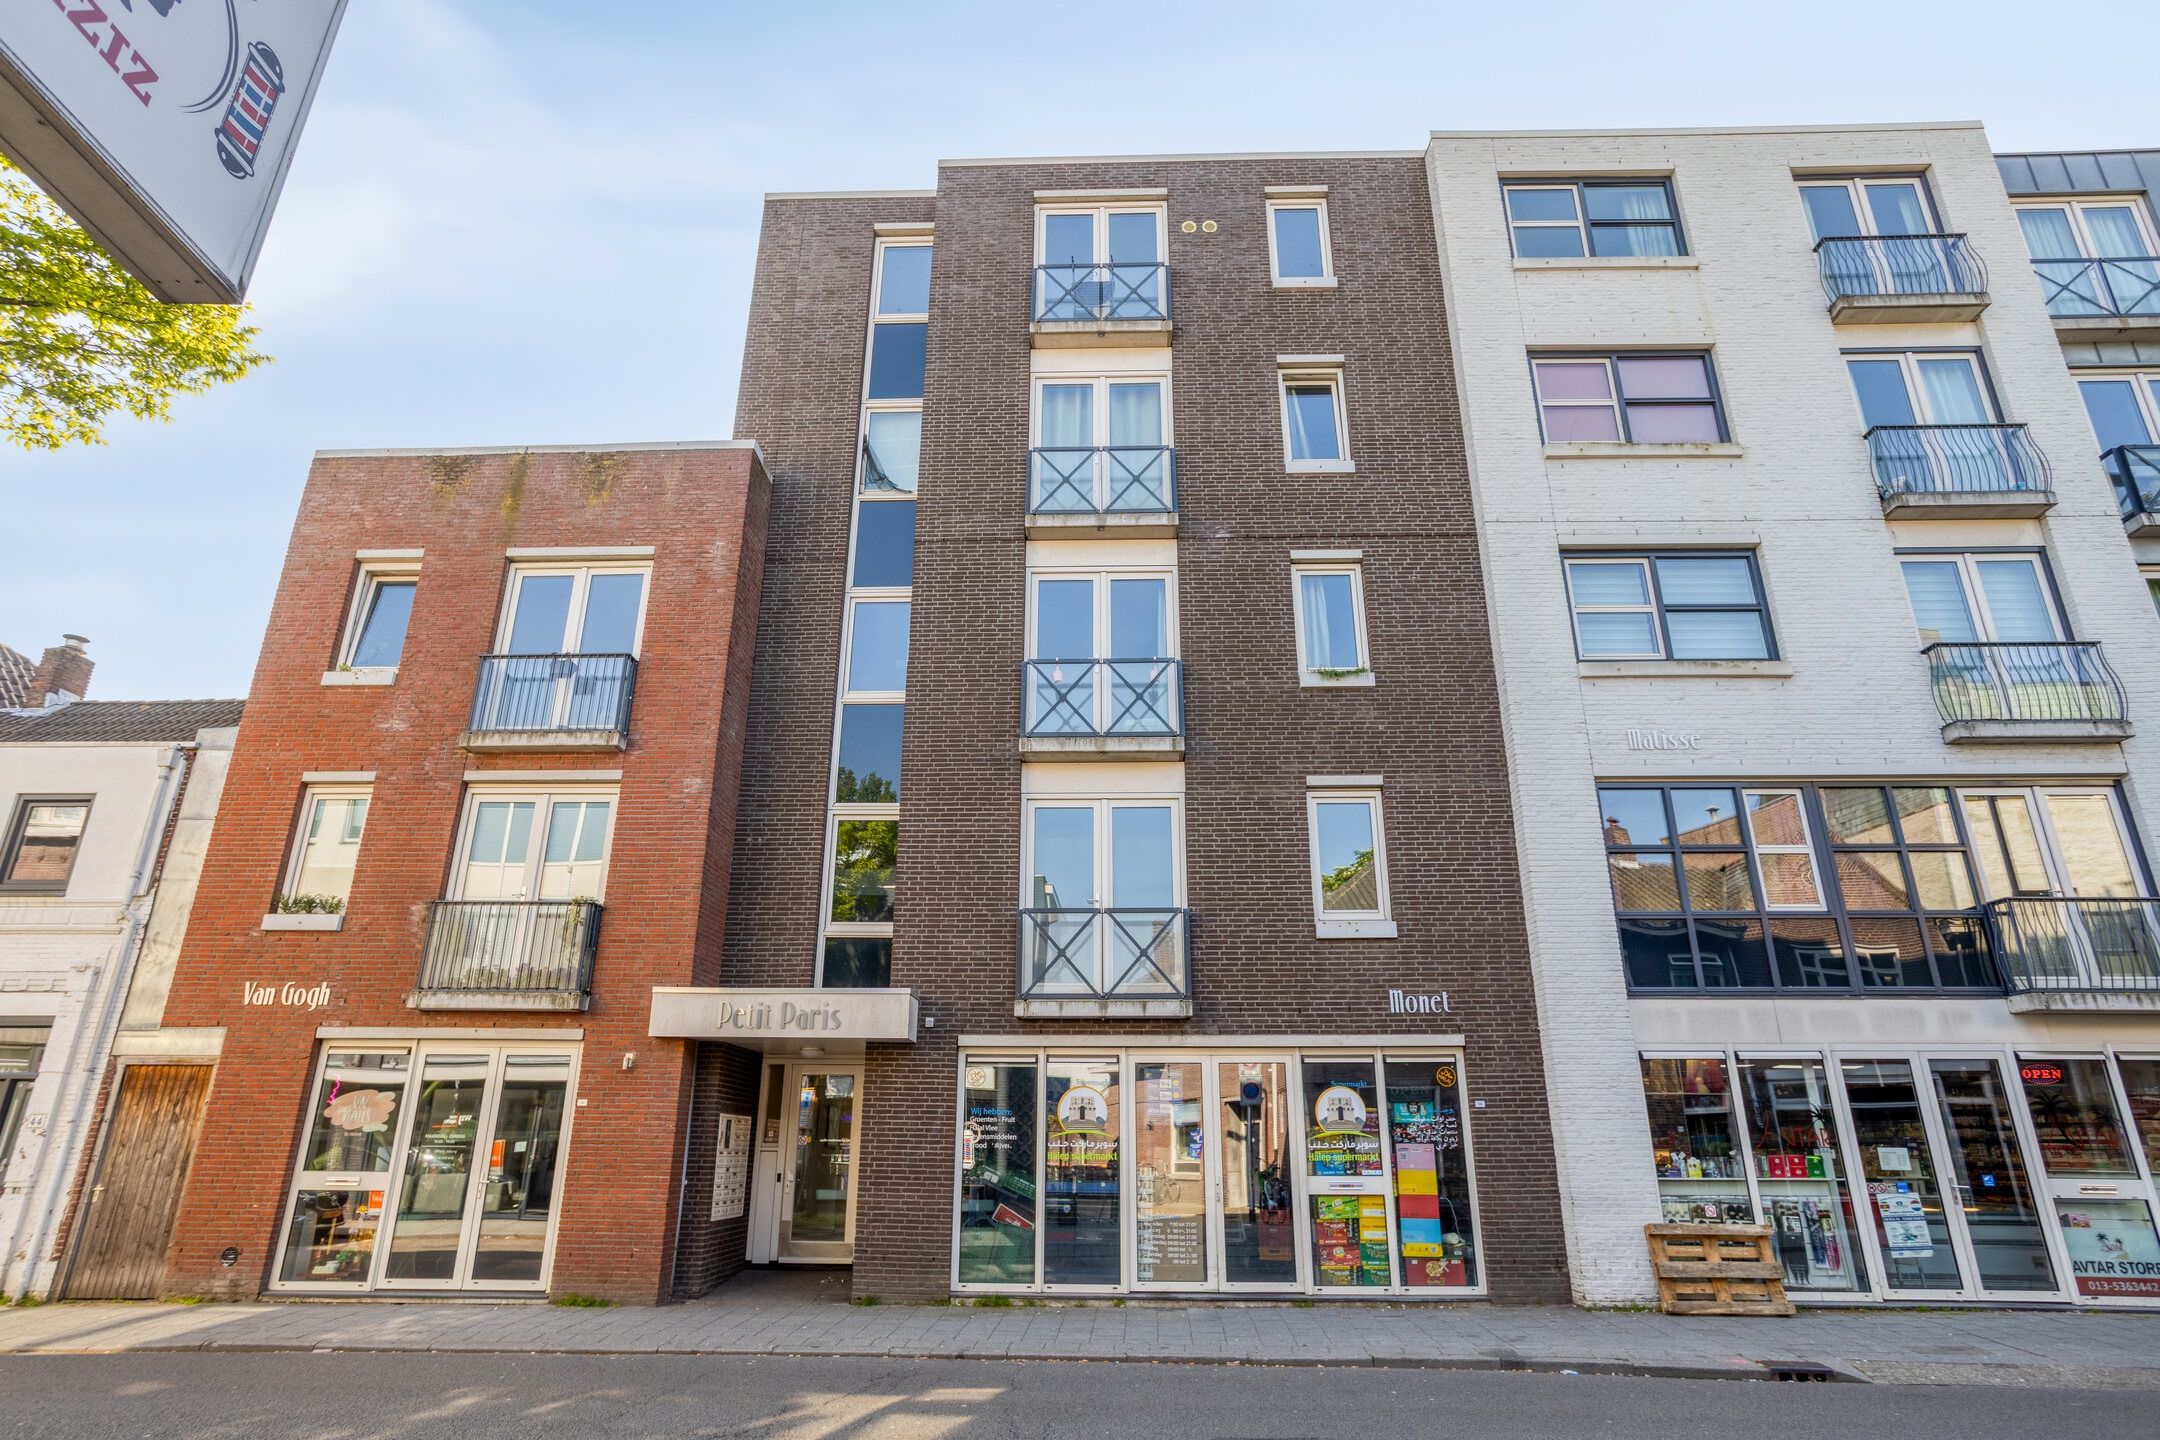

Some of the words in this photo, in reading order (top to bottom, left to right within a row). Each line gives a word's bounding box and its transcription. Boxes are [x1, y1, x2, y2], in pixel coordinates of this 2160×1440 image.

[53, 0, 159, 107] ZIZ
[1626, 729, 1701, 751] Matisse
[244, 981, 276, 1006] Van
[282, 981, 331, 1012] Gogh
[1389, 989, 1452, 1013] Monet
[716, 1001, 772, 1029] Petit
[781, 1001, 842, 1030] Paris
[2022, 1069, 2062, 1079] OPEN
[1330, 1080, 1367, 1088] Supermarkt
[970, 1107, 982, 1116] Wij
[983, 1108, 1012, 1116] hebben:
[1047, 1152, 1070, 1162] Halep
[1071, 1152, 1118, 1162] supermarkt
[1308, 1152, 1331, 1162] Halep
[1333, 1152, 1380, 1162] supermarkt
[2073, 1260, 2116, 1274] AVTAR
[2088, 1281, 2159, 1292] 013-5363442
